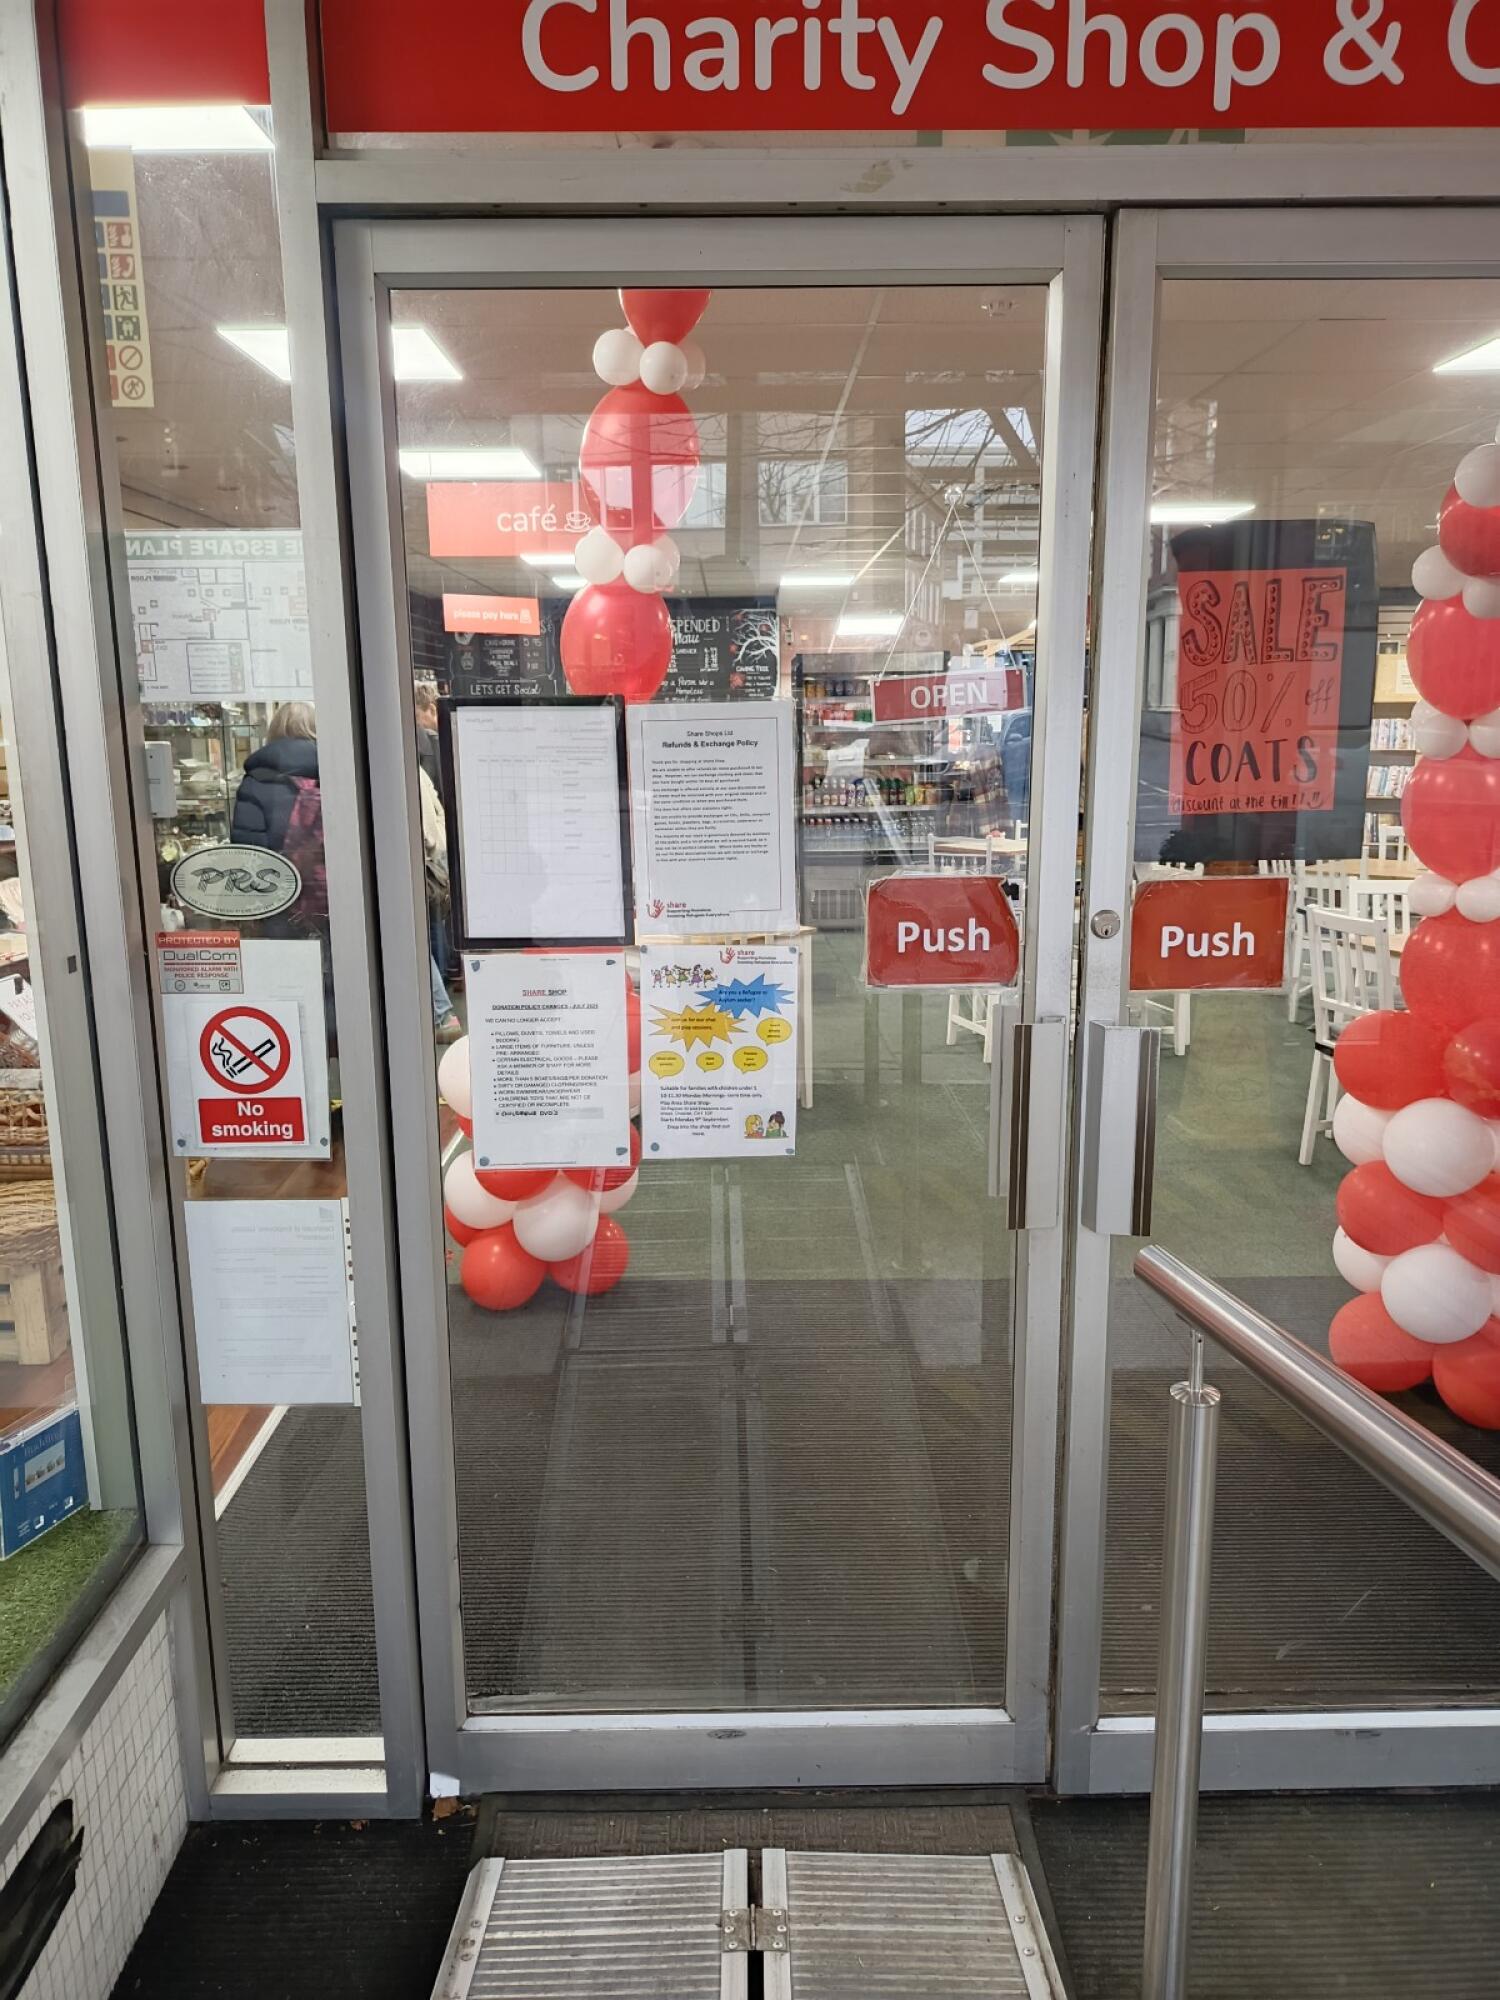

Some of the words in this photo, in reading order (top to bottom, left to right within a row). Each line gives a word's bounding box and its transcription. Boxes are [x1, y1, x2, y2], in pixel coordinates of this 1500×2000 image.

[522, 0, 943, 115] Charity
[982, 0, 1281, 112] Shop
[1323, 0, 1404, 85] &
[496, 503, 558, 532] café
[454, 609, 480, 620] please
[483, 611, 498, 621] pay
[500, 611, 519, 620] here
[1182, 576, 1344, 666] SALE
[470, 684, 494, 696] LETS
[496, 684, 512, 696] GET
[910, 681, 989, 710] OPEN
[1180, 669, 1297, 735] 50%
[1304, 677, 1335, 715] off
[700, 740, 735, 748] Exchange
[736, 740, 758, 748] Policy
[1185, 735, 1318, 786] COATS
[1229, 796, 1241, 809] at
[1244, 795, 1265, 808] the
[190, 867, 281, 893] PRS
[158, 936, 221, 945] PROTECTED
[223, 936, 238, 944] BY
[898, 917, 991, 953] Push
[1160, 922, 1255, 958] Push
[163, 950, 236, 960] DualCom
[237, 1101, 264, 1116] No
[212, 1120, 293, 1139] smoking
